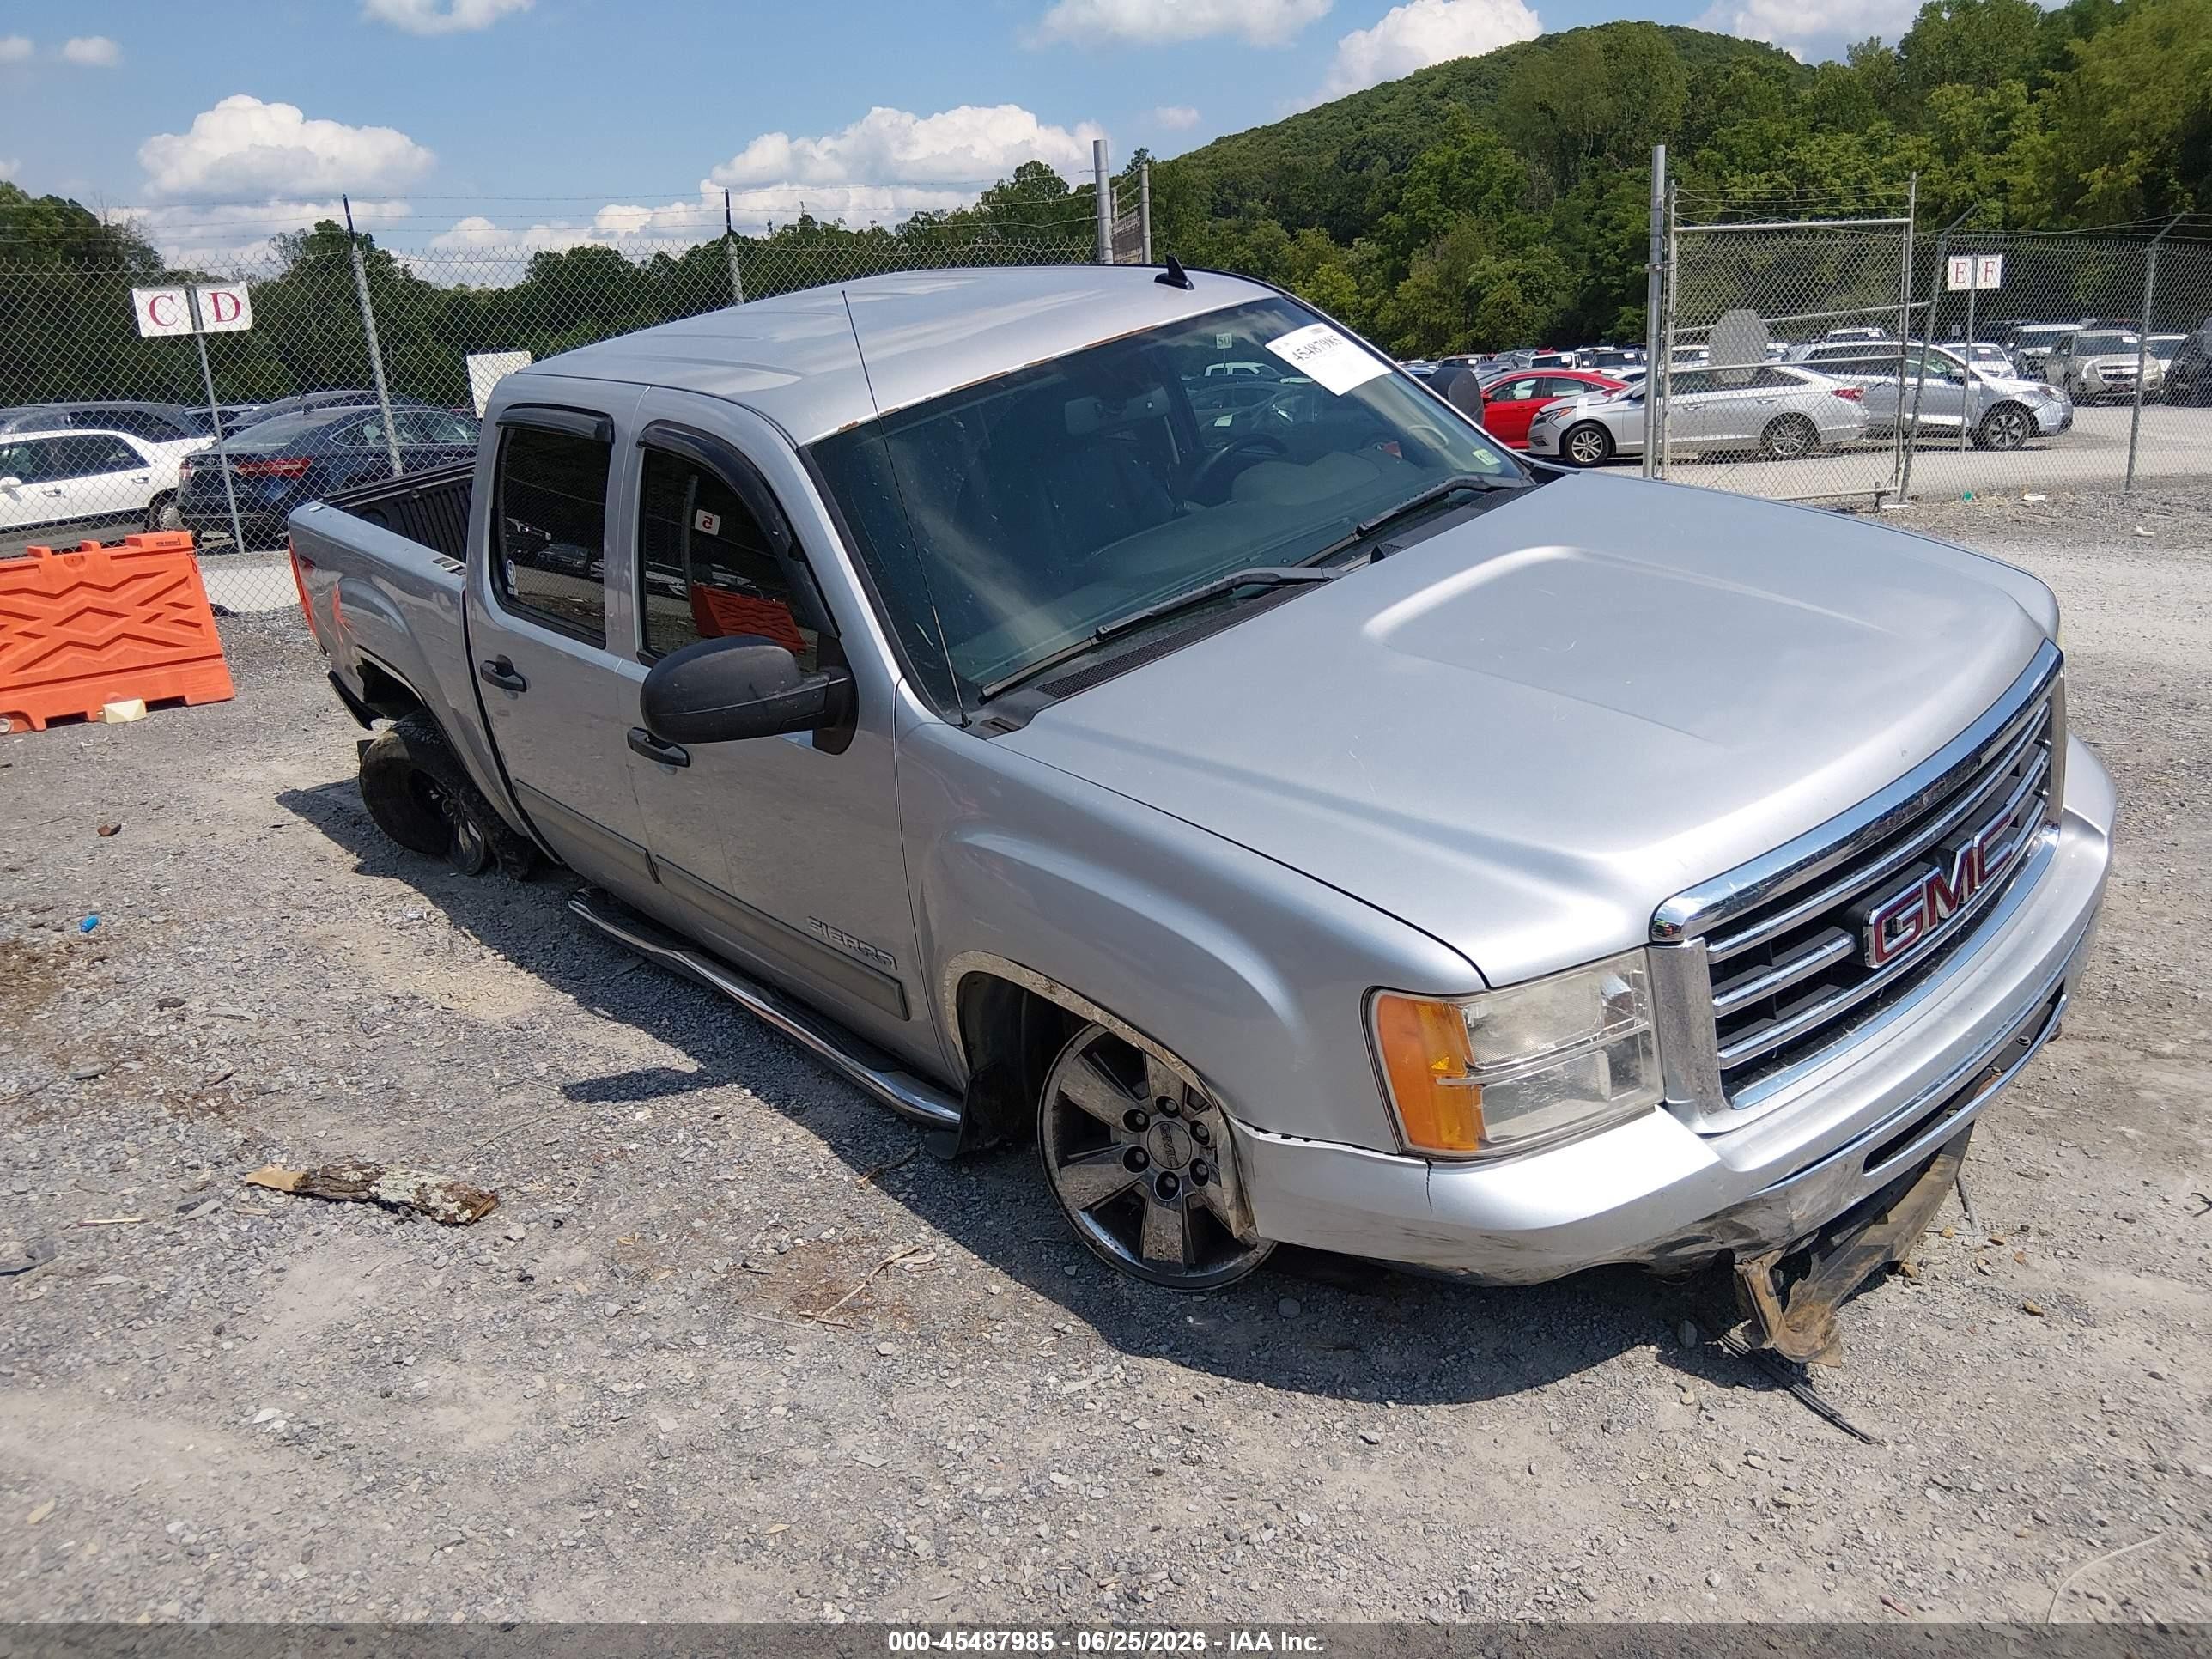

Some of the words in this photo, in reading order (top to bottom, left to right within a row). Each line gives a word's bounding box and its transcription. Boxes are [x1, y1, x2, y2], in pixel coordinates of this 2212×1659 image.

[1954, 262, 1966, 283] E
[1984, 261, 1996, 282] F
[149, 294, 179, 327] C
[209, 291, 241, 323] D
[1218, 336, 1231, 346] 50
[1863, 803, 2014, 969] GMC
[808, 915, 898, 971] SIERRA
[1159, 1122, 1180, 1168] GMC
